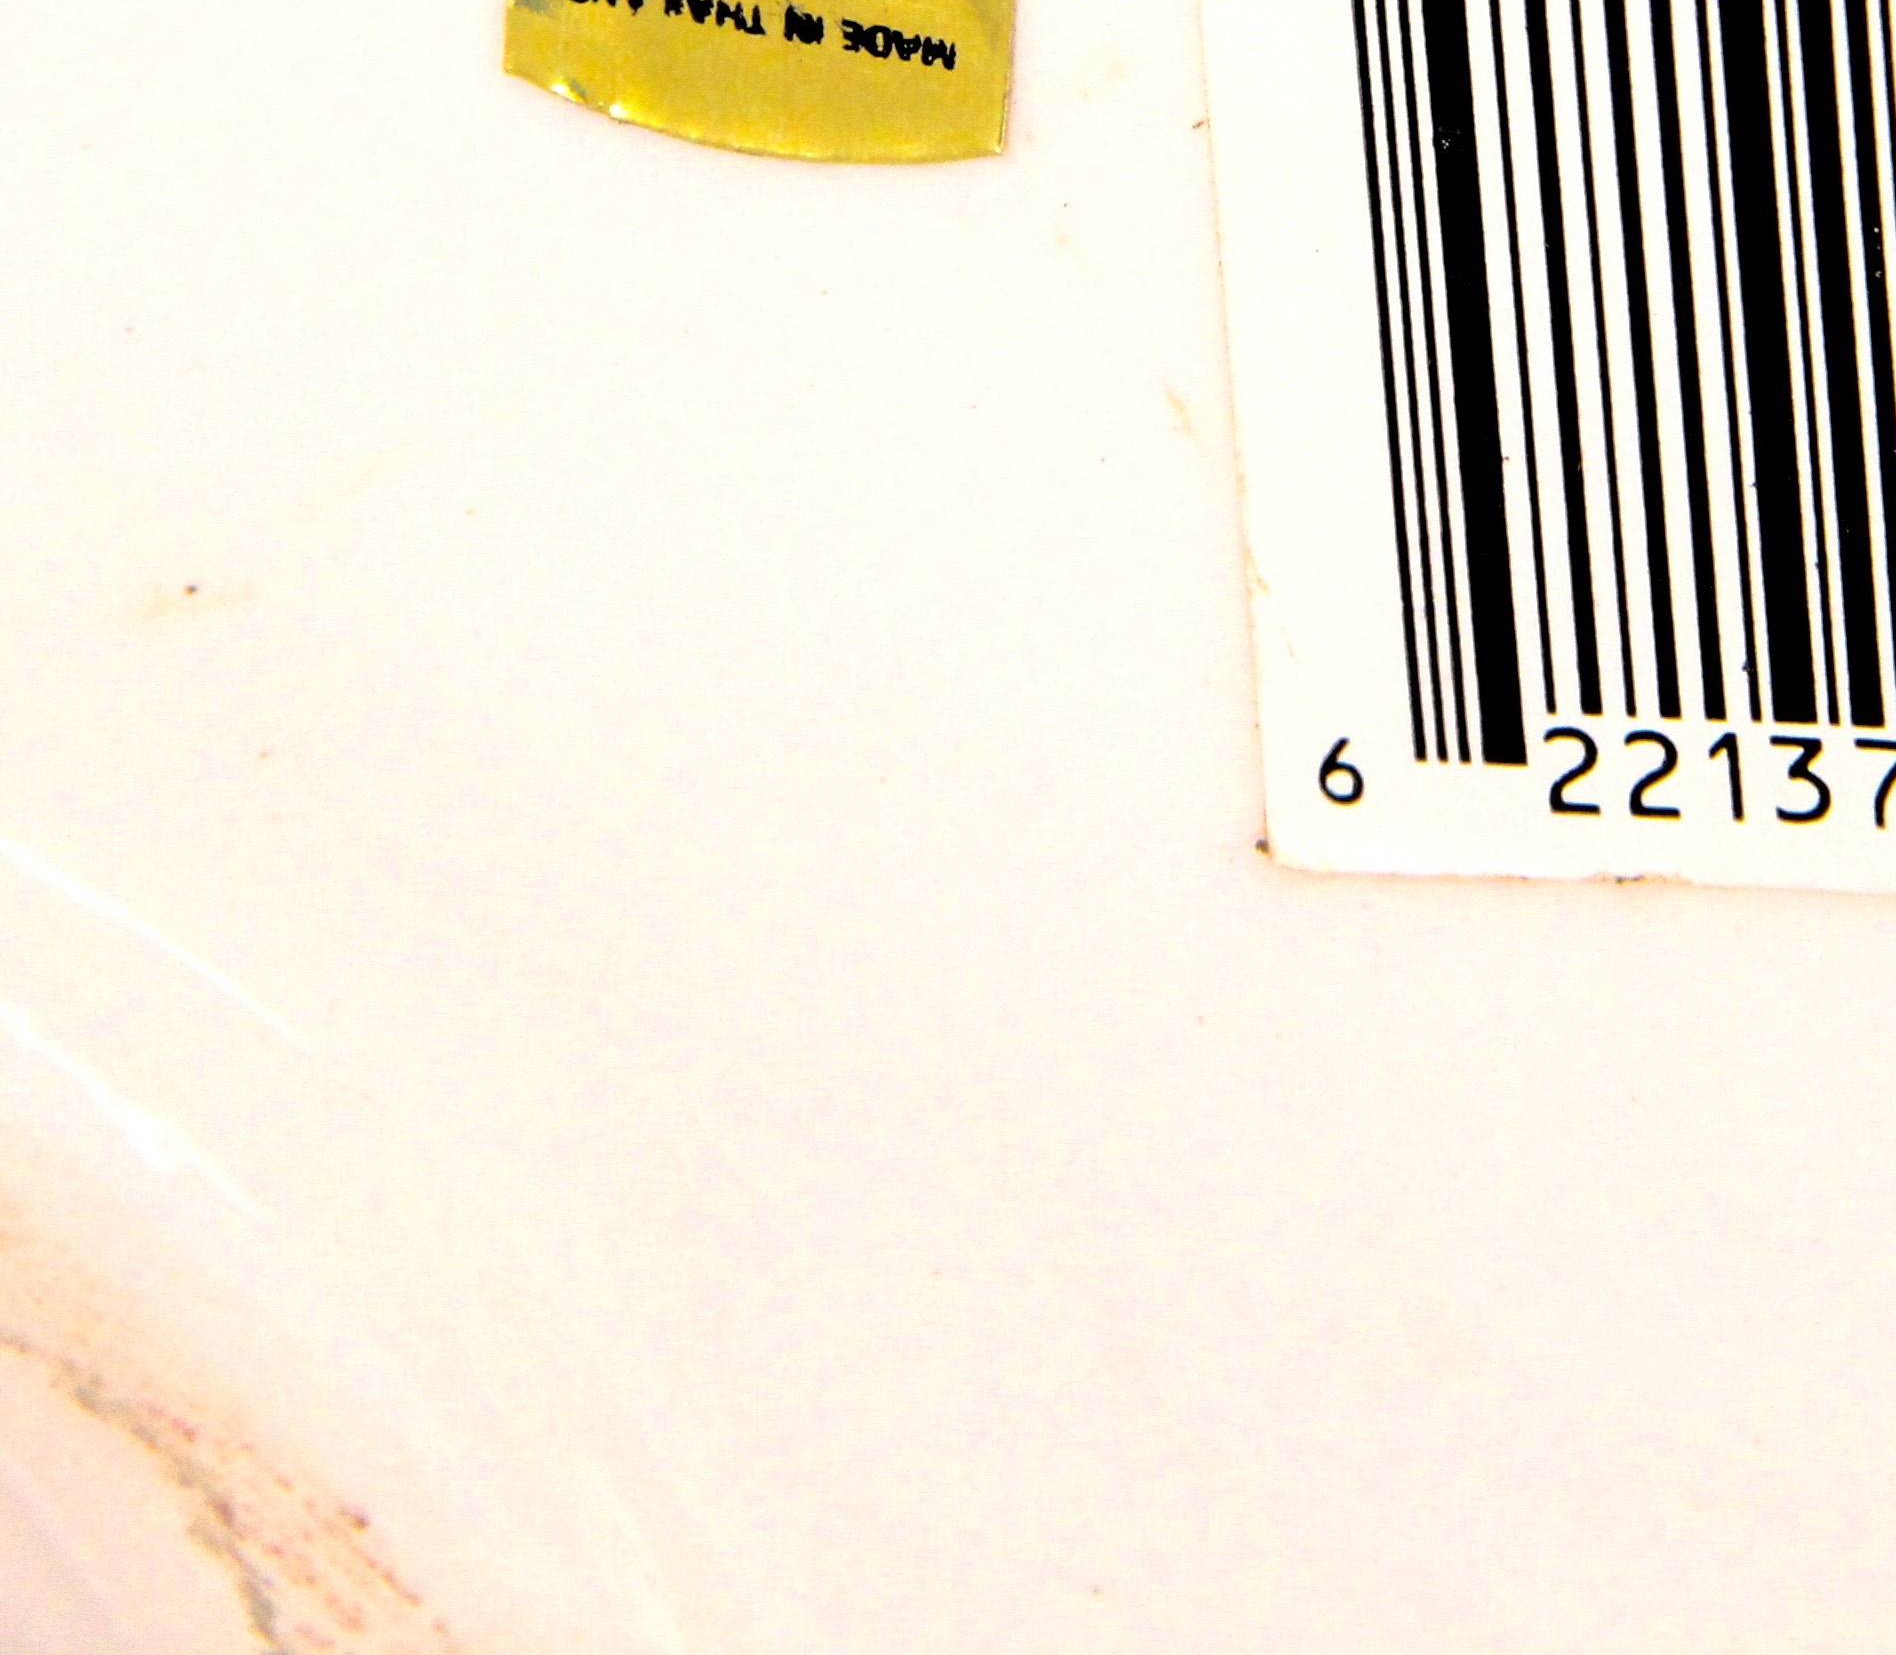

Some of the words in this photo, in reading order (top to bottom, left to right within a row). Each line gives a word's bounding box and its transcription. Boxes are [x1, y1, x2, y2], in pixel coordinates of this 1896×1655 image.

[783, 4, 825, 45] IN
[841, 18, 957, 71] MADE
[1318, 737, 1364, 805] 6
